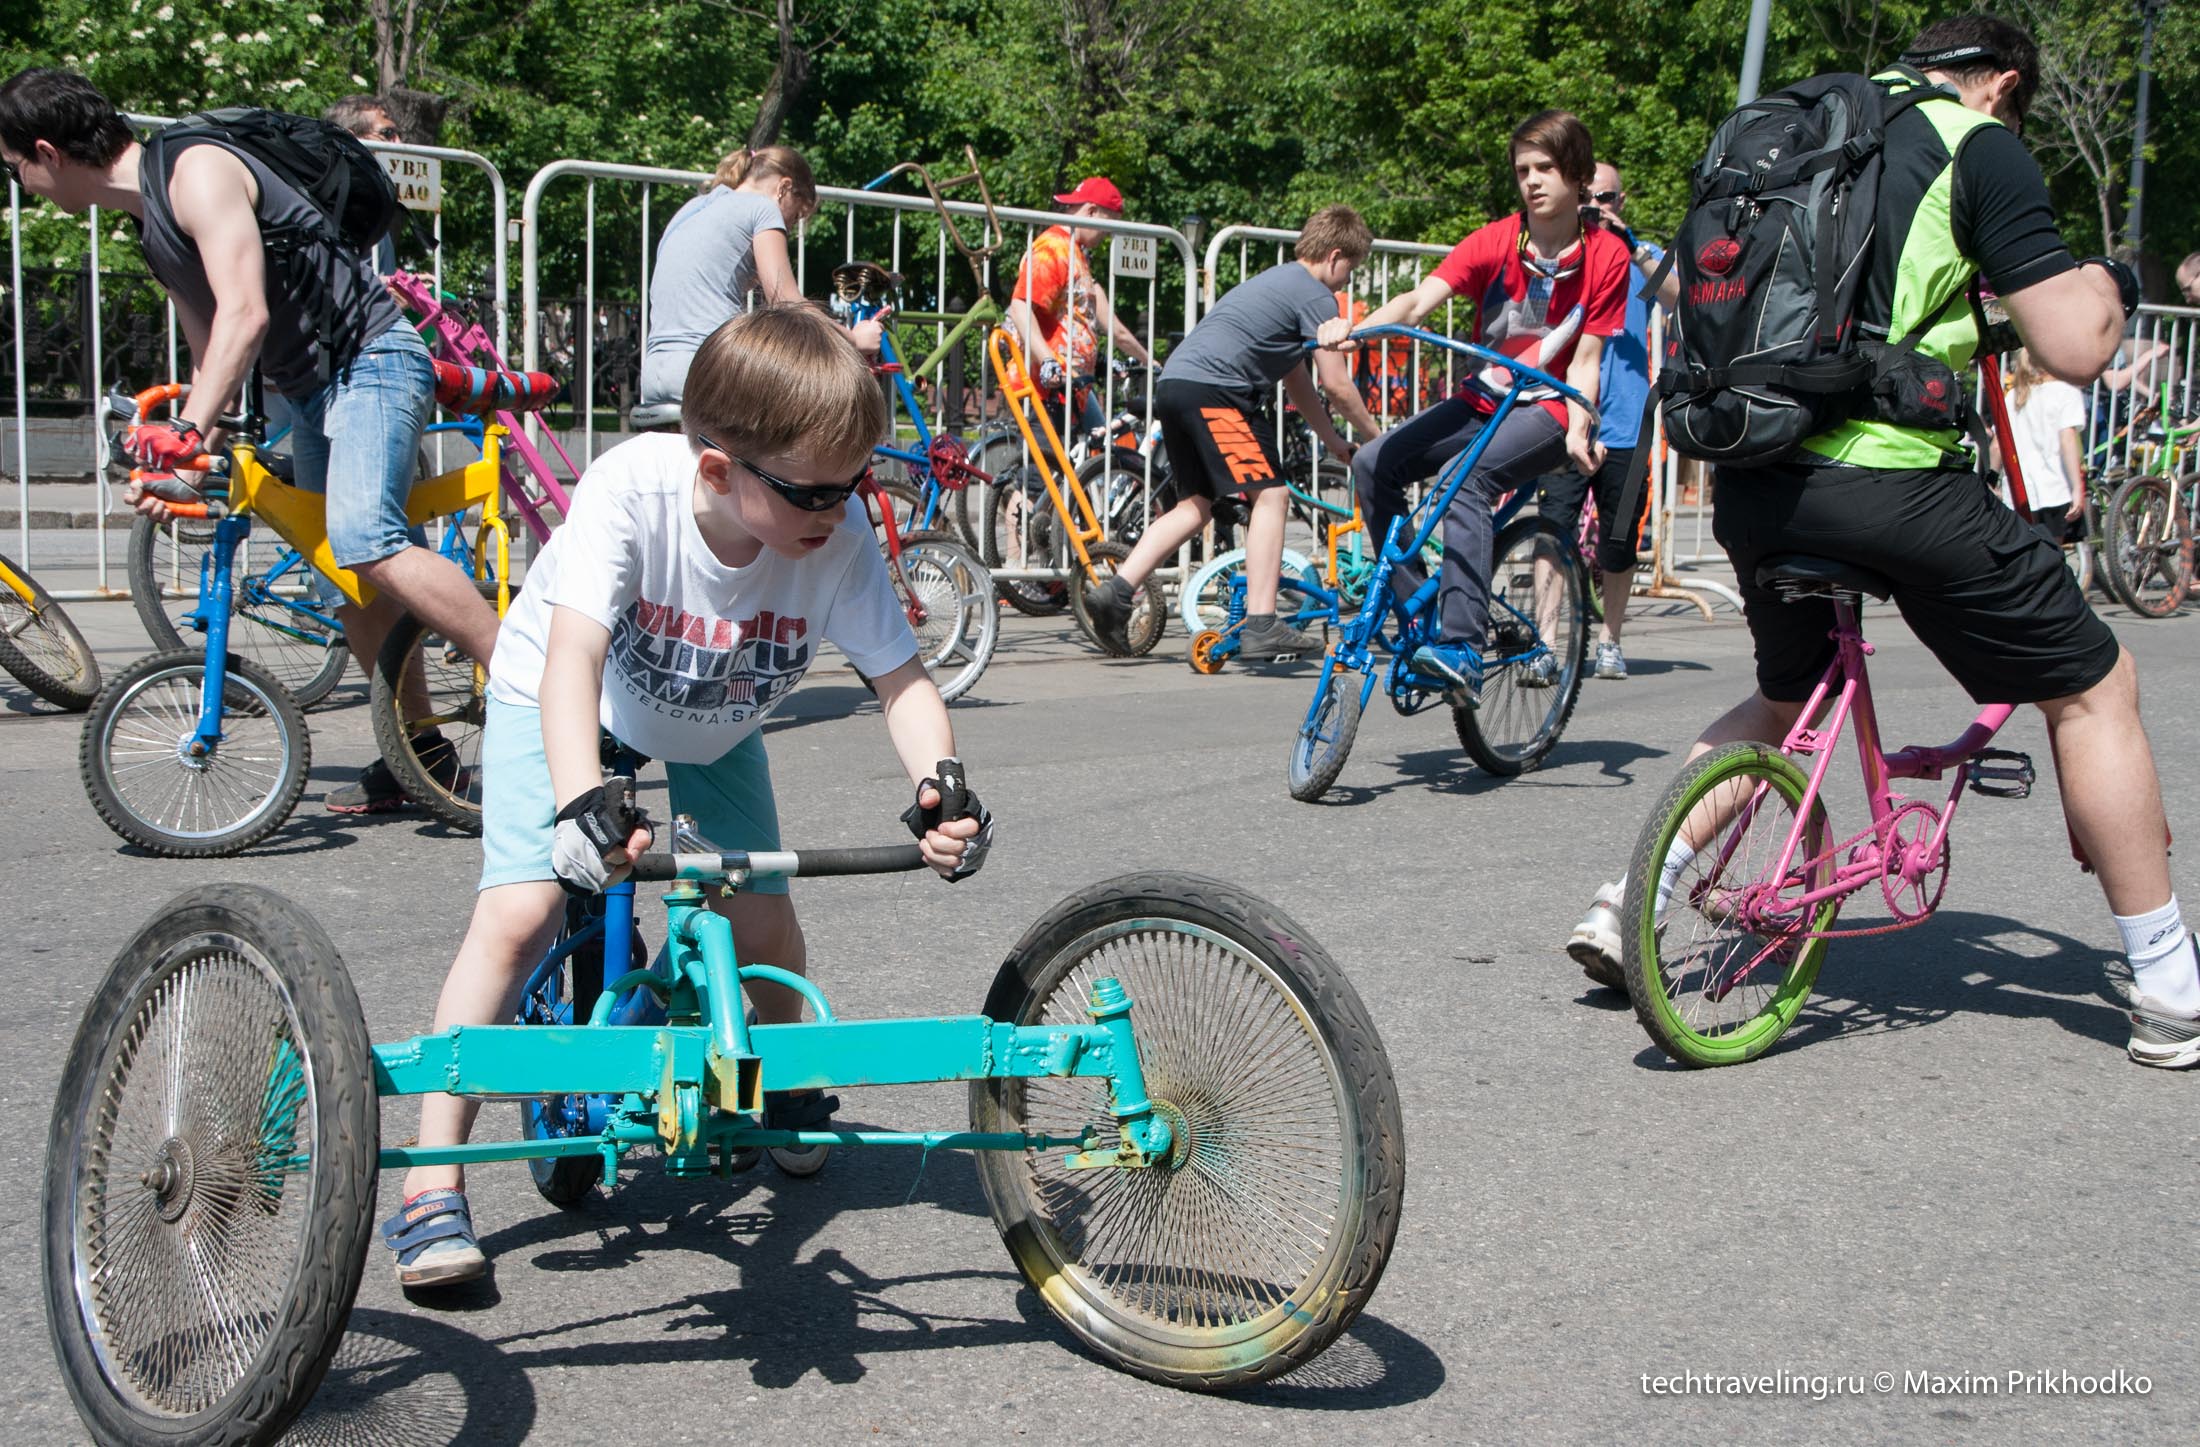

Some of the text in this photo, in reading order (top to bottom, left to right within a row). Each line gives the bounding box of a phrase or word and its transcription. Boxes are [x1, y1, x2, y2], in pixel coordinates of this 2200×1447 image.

[1927, 46, 1982, 63] SUNGLASSES
[389, 159, 429, 180] УВД
[1122, 237, 1148, 253] УВД
[1121, 255, 1148, 271] ЦАО
[1200, 406, 1275, 485] NIKE
[612, 622, 691, 706] TEAM
